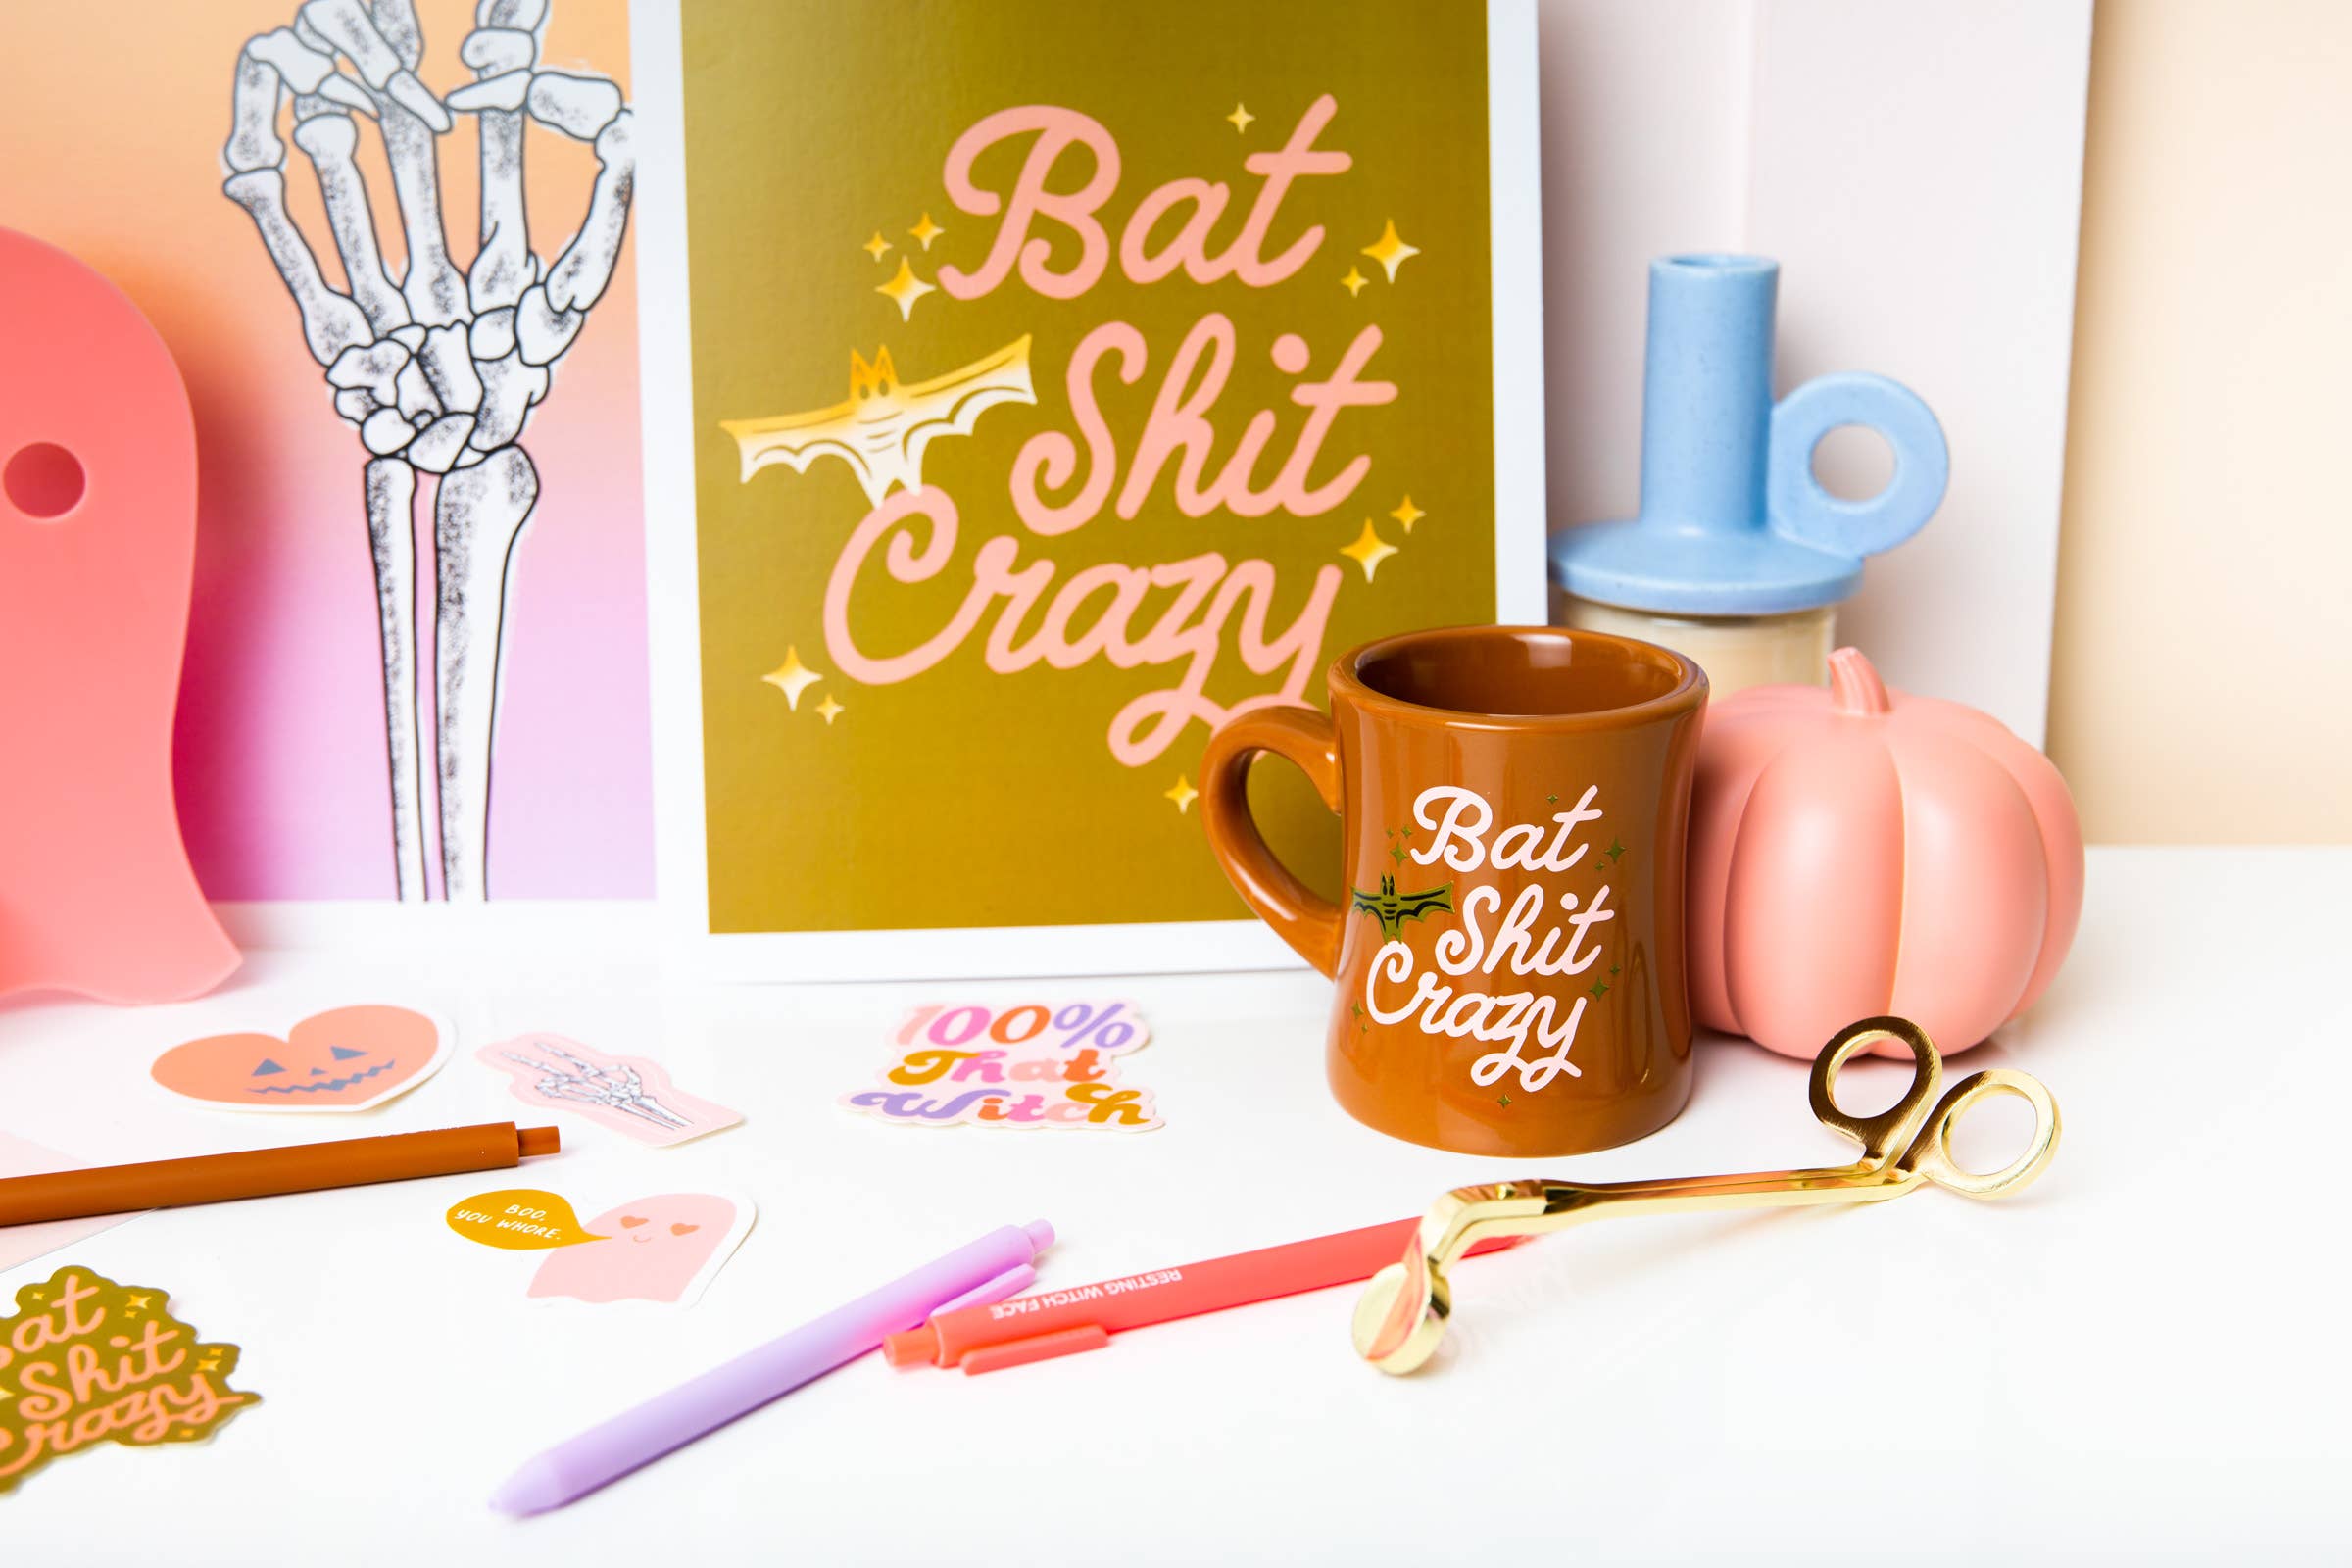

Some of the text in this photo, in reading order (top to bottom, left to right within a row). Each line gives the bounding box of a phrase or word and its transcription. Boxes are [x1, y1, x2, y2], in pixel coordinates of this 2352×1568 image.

[937, 94, 1352, 300] Bat
[1009, 313, 1398, 536] Shit
[823, 484, 1343, 766] Crazy
[1410, 785, 1603, 873] Bat
[1435, 884, 1615, 976] Shit
[896, 1003, 1135, 1048] 100%
[1366, 941, 1587, 1093] Crazy
[850, 1082, 1152, 1125] Witch
[887, 1048, 1106, 1086] That
[454, 1209, 562, 1240] YOU WHORE.
[0, 1274, 107, 1370] at
[989, 1269, 1182, 1320] RESTING WITCH FACE
[18, 1320, 187, 1421] Shit
